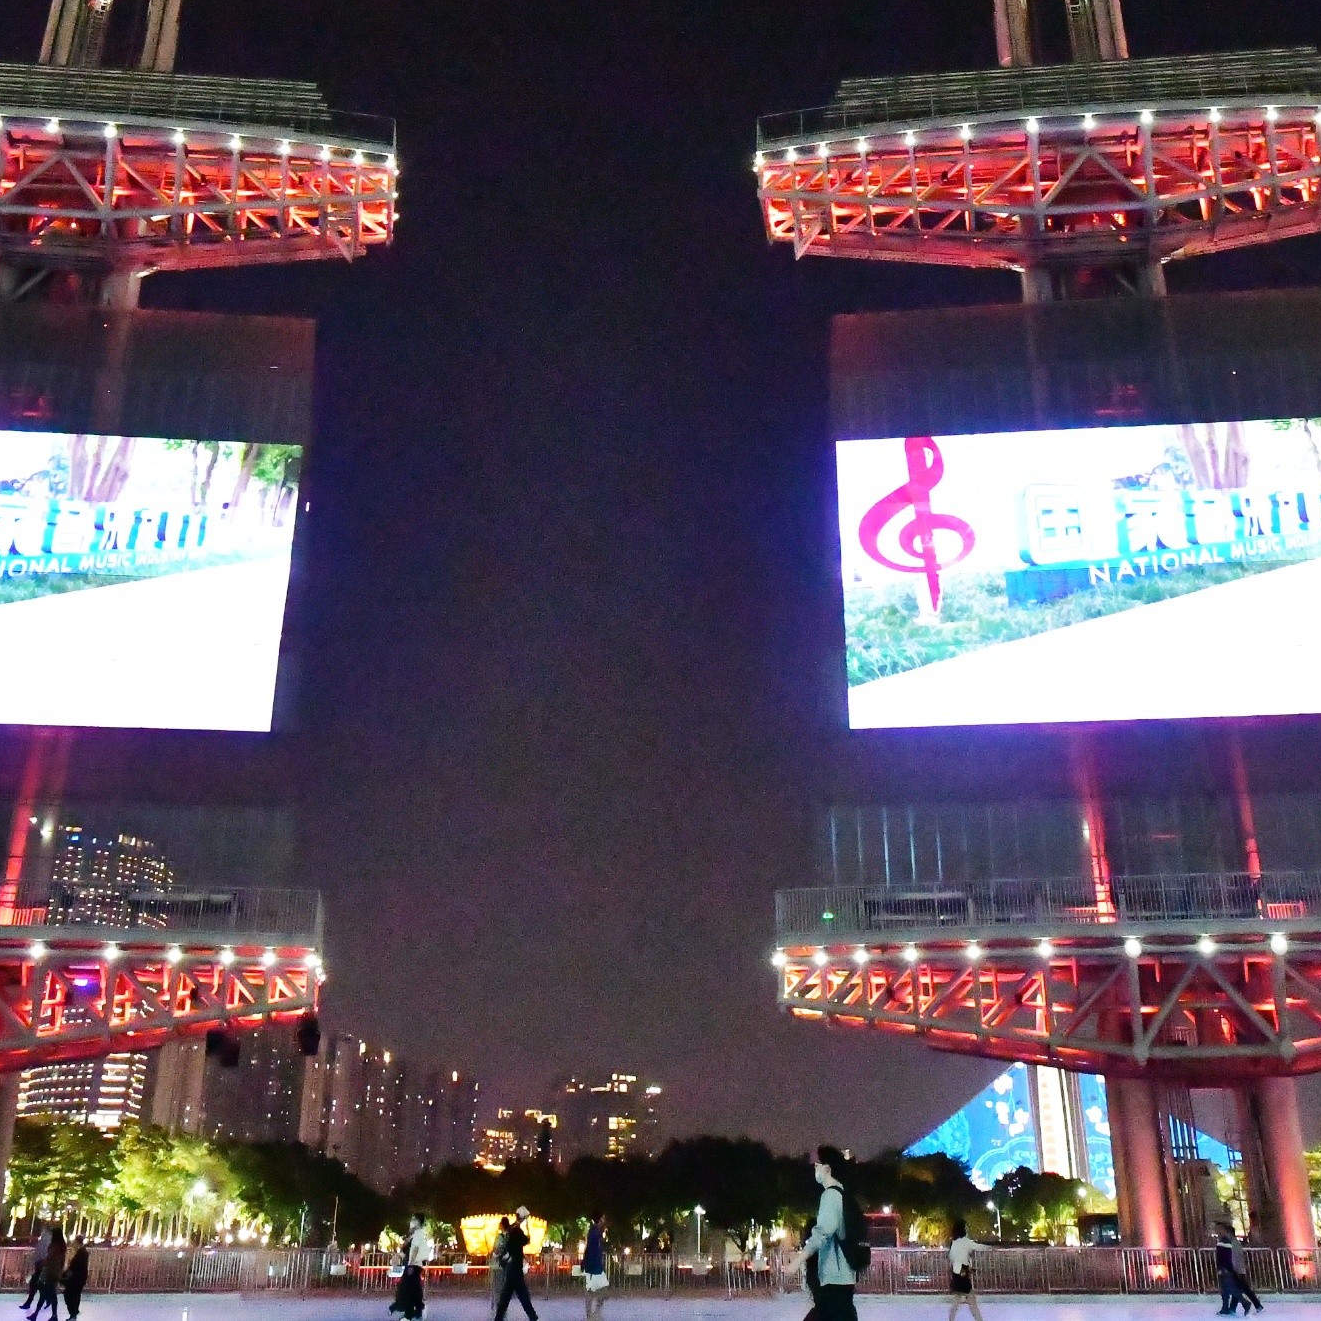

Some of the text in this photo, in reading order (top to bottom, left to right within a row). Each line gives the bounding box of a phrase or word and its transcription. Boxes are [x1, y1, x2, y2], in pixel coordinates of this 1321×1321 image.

[80, 552, 131, 570] MUSIC
[1089, 546, 1224, 585] NATIONAL
[1231, 537, 1281, 560] MUSIC
